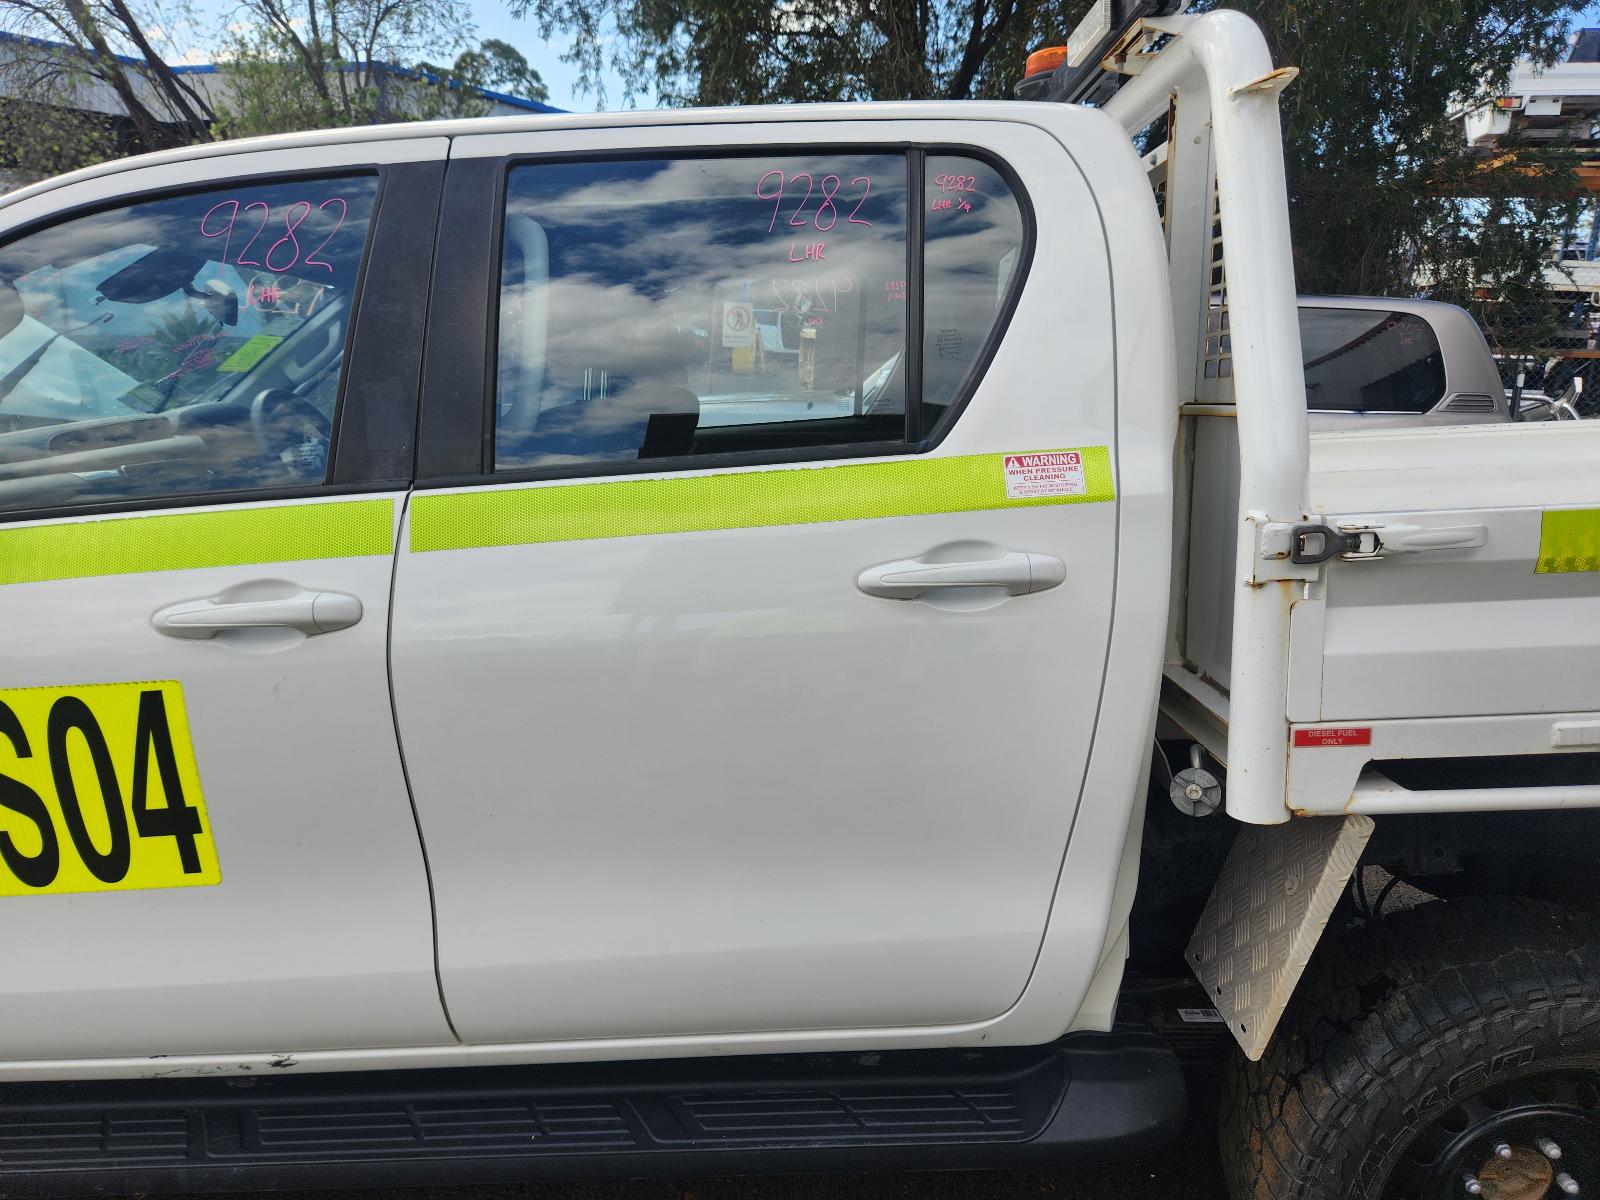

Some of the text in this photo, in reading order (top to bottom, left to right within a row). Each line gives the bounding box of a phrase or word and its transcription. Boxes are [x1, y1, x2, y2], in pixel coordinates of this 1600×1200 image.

[935, 174, 976, 192] 9282
[757, 170, 873, 233] 9282
[201, 198, 348, 276] 9282
[788, 242, 826, 262] LHR
[1021, 453, 1077, 467] WARNING
[1035, 465, 1079, 474] PRESSURE
[1023, 473, 1066, 482] CLEANING
[0, 689, 204, 888] S04
